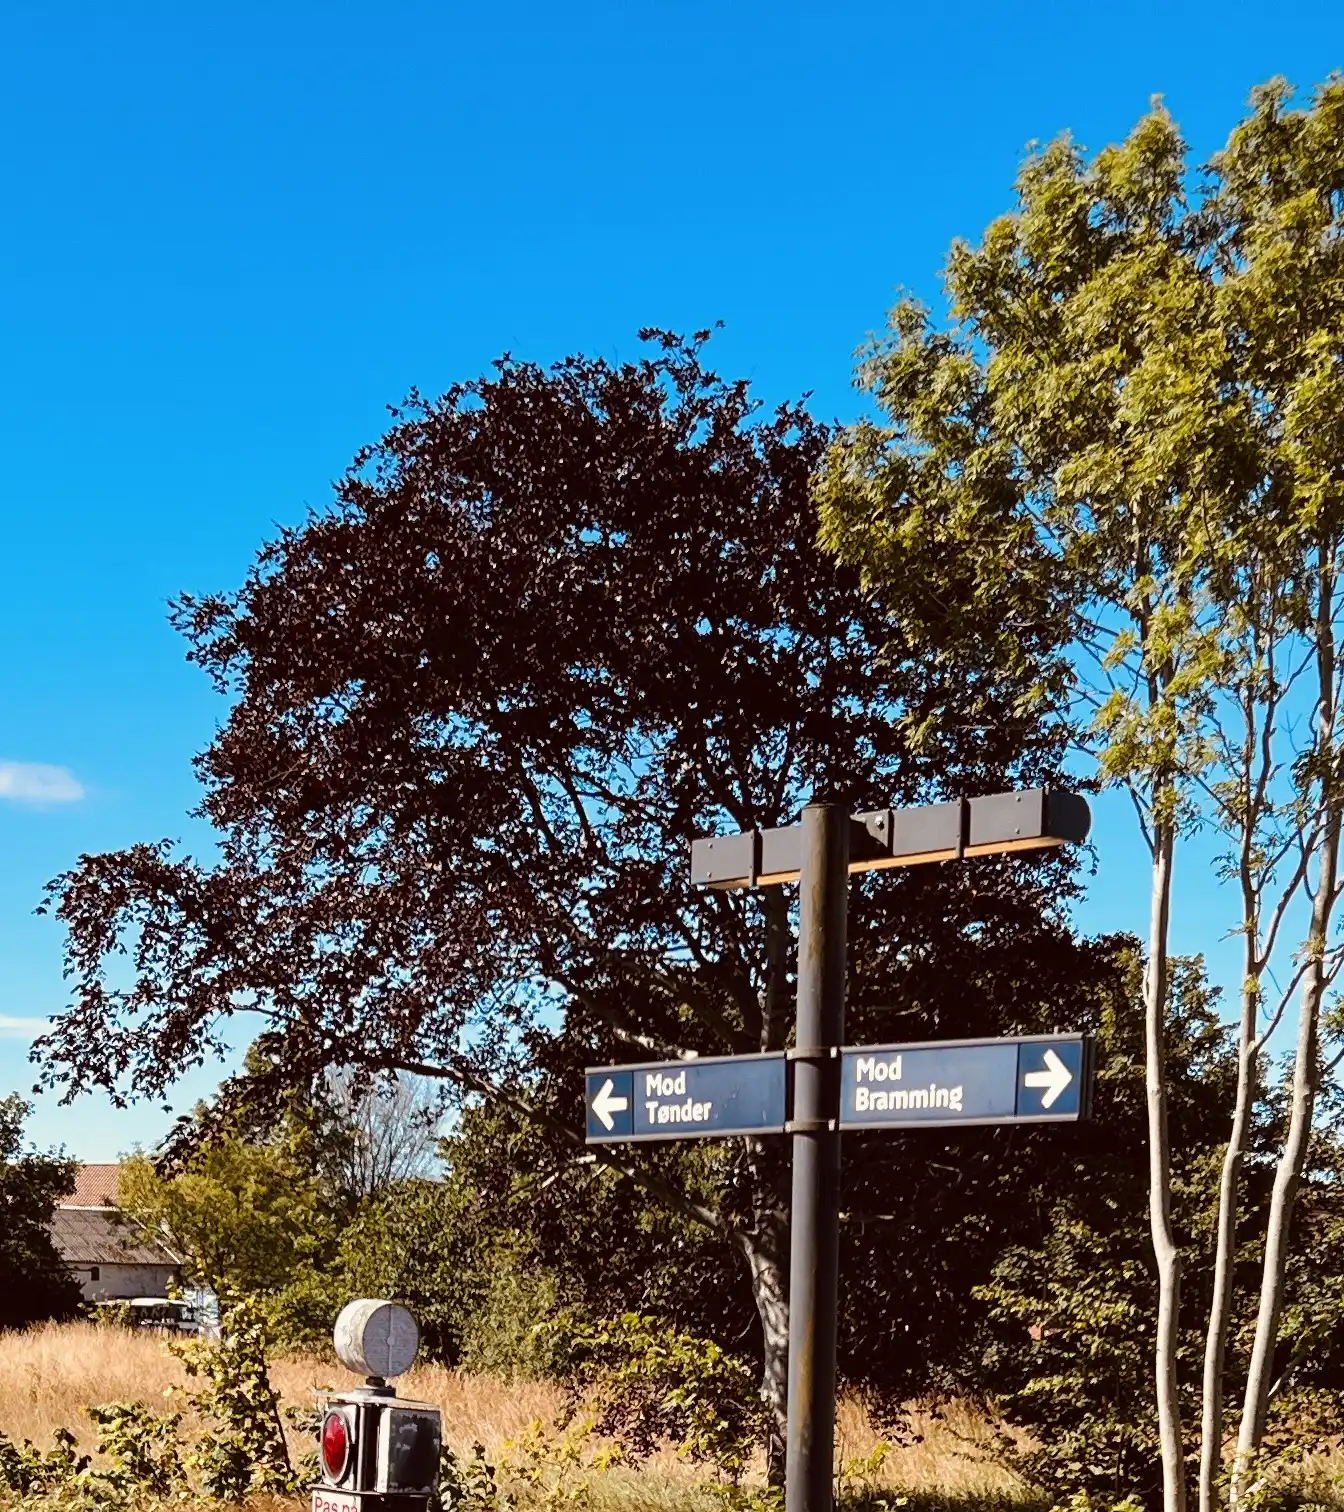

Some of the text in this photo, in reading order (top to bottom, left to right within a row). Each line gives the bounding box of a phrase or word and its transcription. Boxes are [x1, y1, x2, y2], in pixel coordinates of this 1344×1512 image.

[856, 1055, 902, 1082] Mod
[646, 1070, 686, 1097] Mod
[645, 1097, 713, 1124] Tønder
[855, 1083, 963, 1112] Bramming
